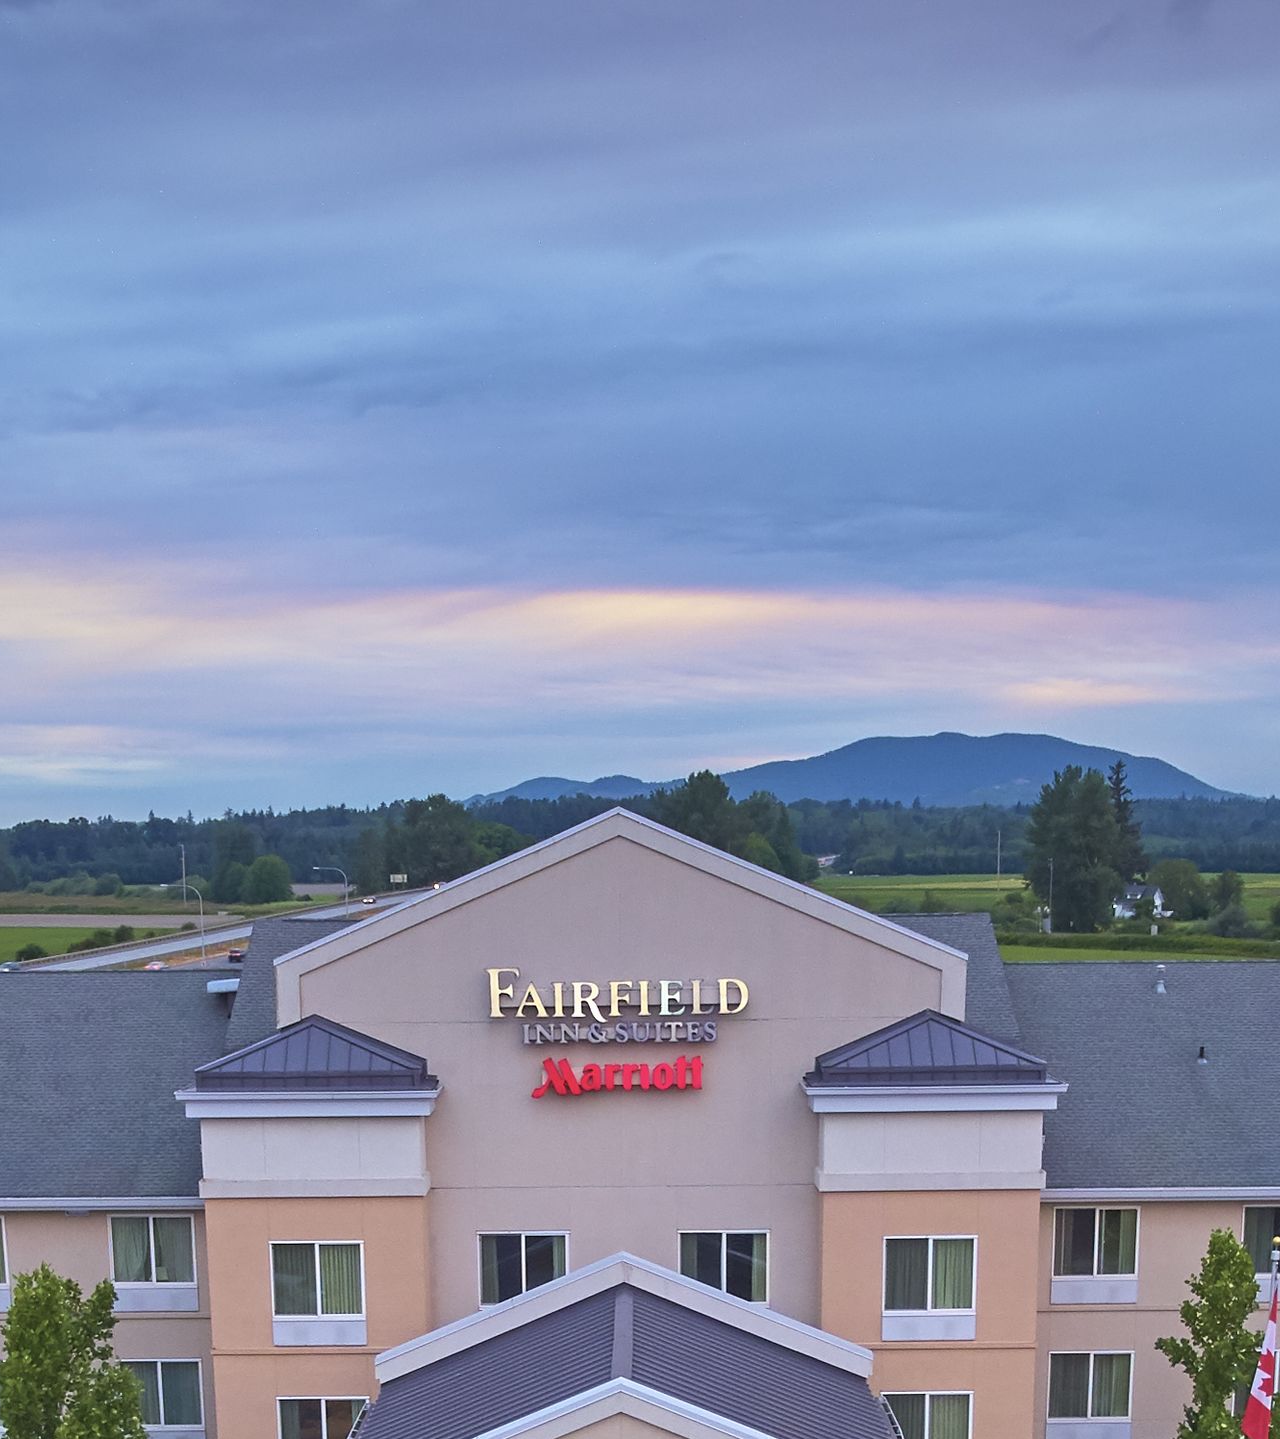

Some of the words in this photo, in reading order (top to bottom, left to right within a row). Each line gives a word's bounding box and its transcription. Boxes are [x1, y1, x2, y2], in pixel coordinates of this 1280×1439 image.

[486, 967, 749, 1022] FAIRFIELD
[523, 1023, 580, 1044] INN
[587, 1023, 609, 1044] &
[615, 1021, 717, 1043] SUITES
[532, 1056, 703, 1098] Marriott
